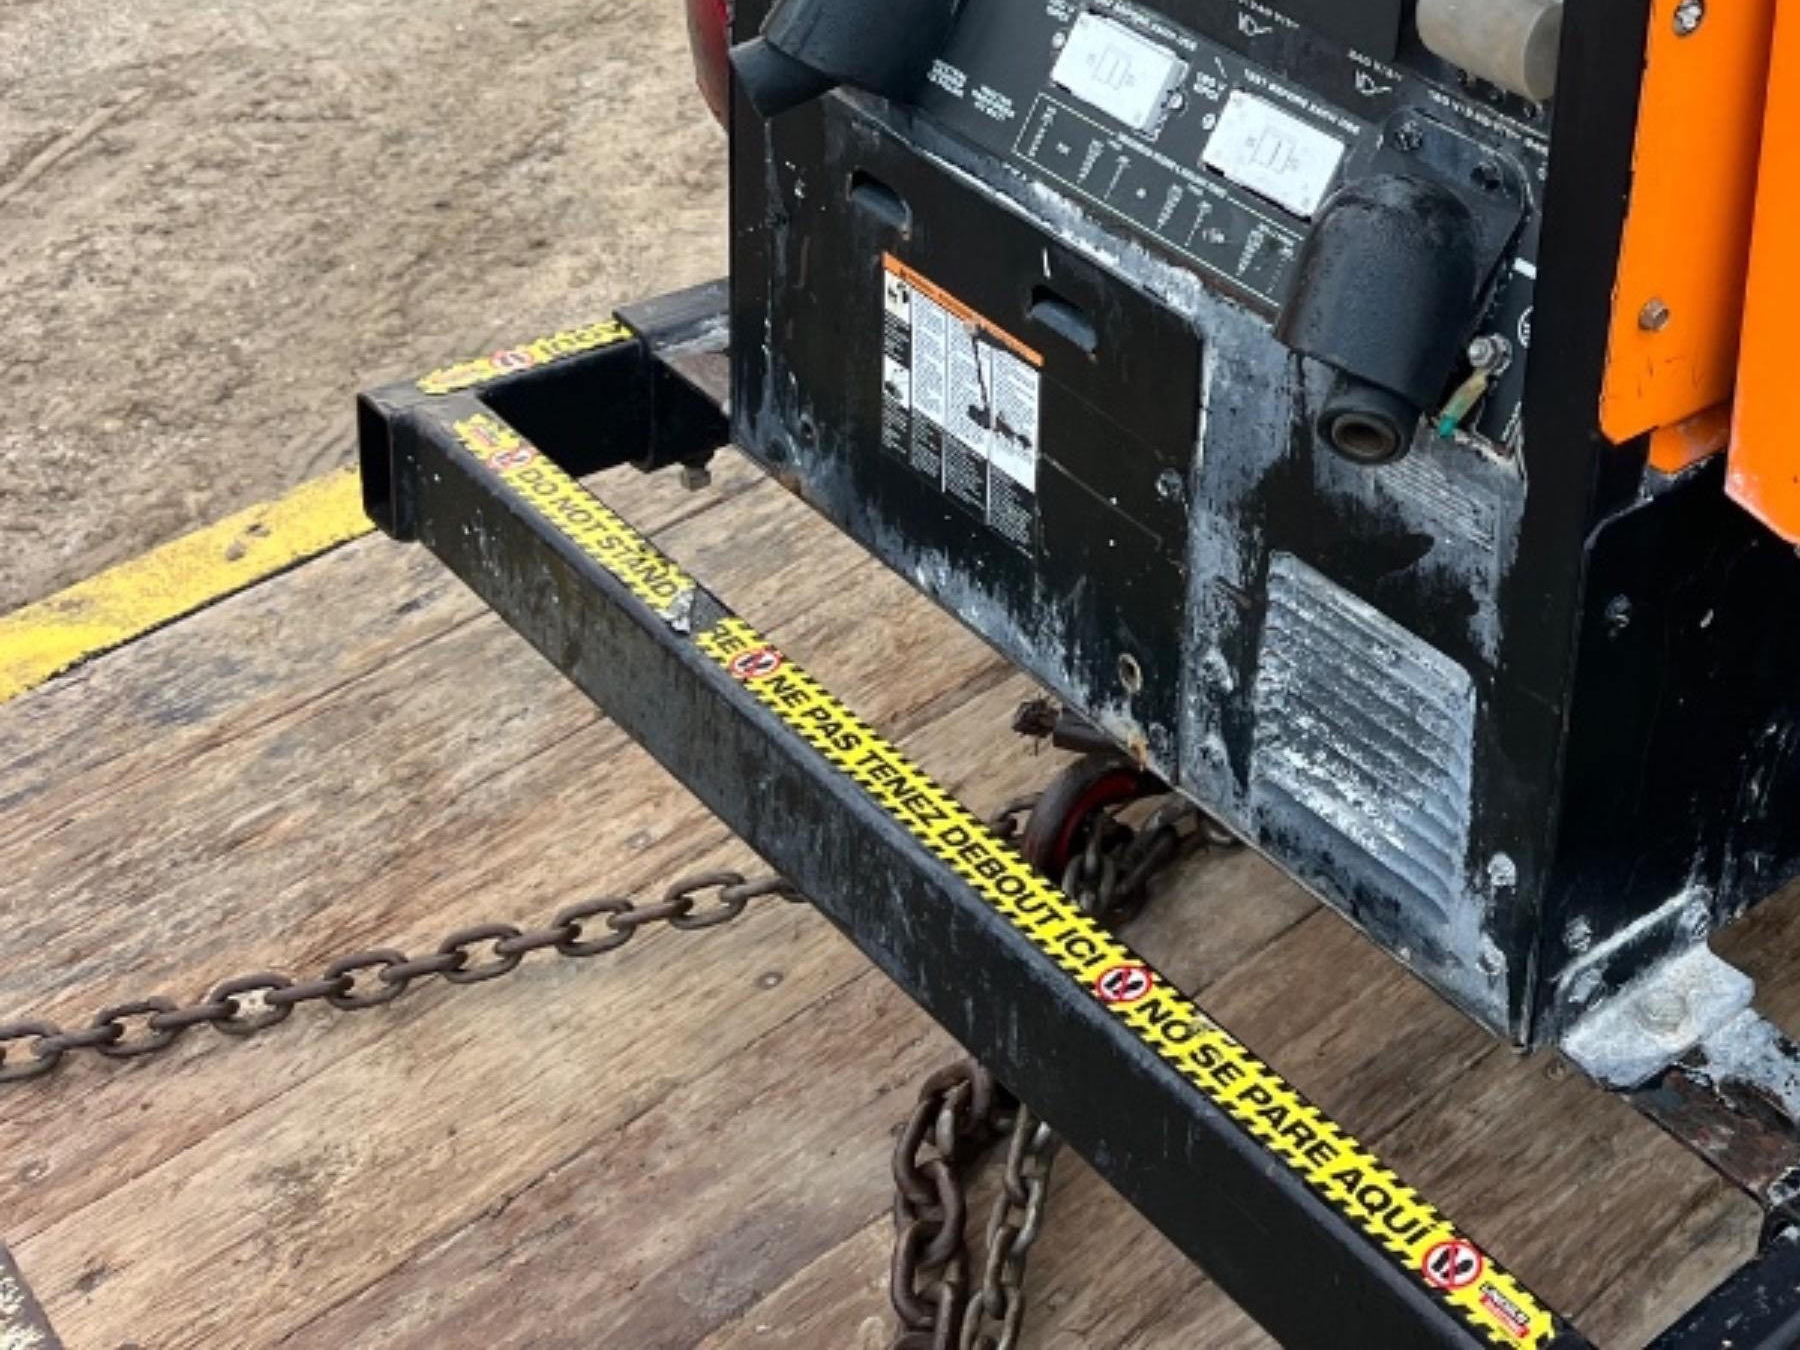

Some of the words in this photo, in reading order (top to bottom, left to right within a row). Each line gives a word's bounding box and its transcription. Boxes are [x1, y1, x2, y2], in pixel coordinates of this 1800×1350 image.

[519, 467, 559, 497] DO
[554, 493, 608, 533] NOT
[598, 533, 679, 599] STAND
[770, 674, 812, 708] NE
[804, 703, 863, 753] PAS
[856, 749, 949, 828] TENEZ
[938, 824, 1066, 927] DEBOUT
[1054, 927, 1109, 969] ICI
[1134, 998, 1199, 1044] NO
[1188, 1043, 1246, 1088] SE
[1236, 1082, 1341, 1169] PARE
